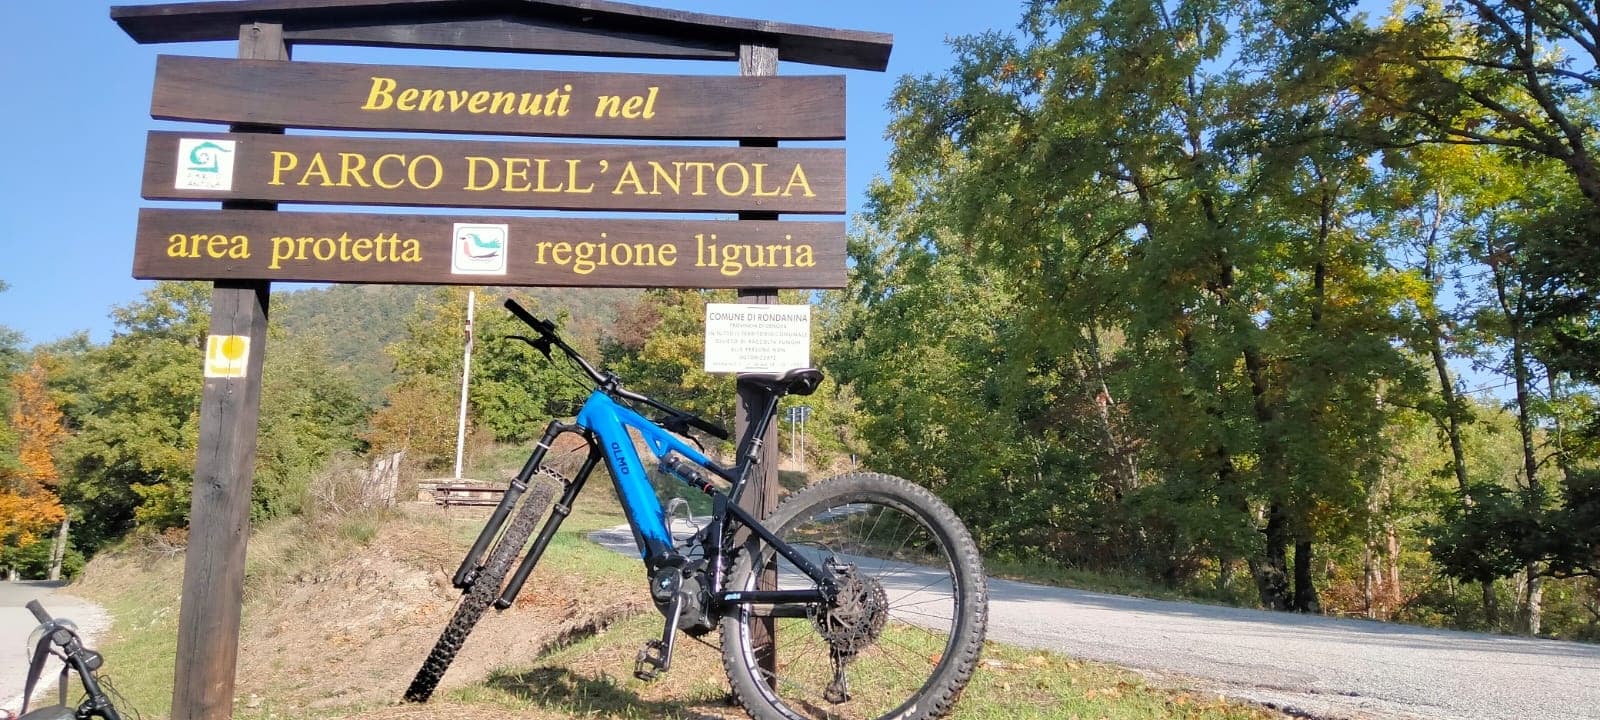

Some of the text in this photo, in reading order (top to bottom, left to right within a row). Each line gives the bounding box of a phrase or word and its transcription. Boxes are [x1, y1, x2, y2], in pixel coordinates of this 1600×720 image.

[361, 76, 660, 120] Benvenuti nel
[268, 150, 444, 190] PARCO
[166, 231, 423, 270] area protetta
[535, 232, 817, 277] regione liguria
[709, 312, 808, 322] COMUNE DI RONDANINA
[611, 442, 630, 475] OLMO
